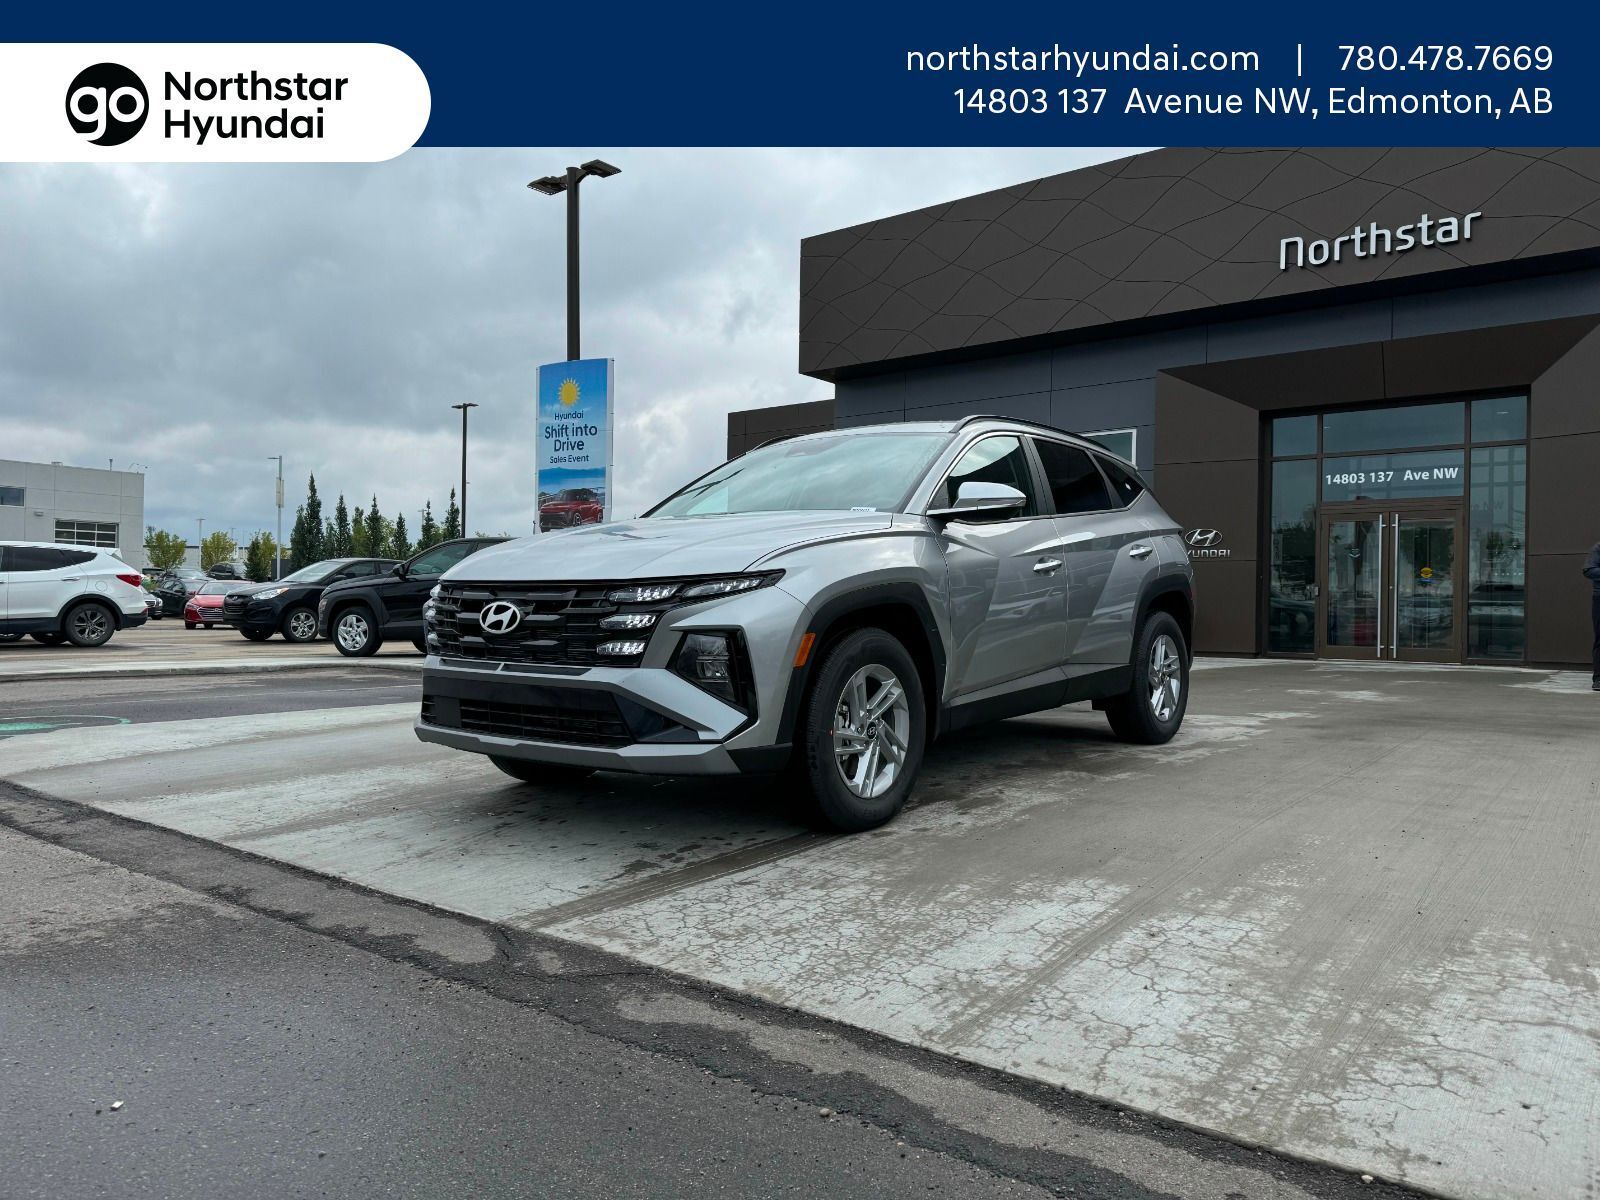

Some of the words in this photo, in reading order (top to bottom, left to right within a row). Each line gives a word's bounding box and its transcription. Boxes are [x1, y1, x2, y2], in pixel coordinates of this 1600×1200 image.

[554, 410, 584, 421] Hyundai
[544, 424, 569, 439] Shift
[572, 423, 598, 437] into
[554, 438, 585, 452] Drive
[550, 456, 567, 464] Sales
[568, 454, 589, 463] Event
[1325, 472, 1366, 485] 14803
[1369, 471, 1394, 483] 137
[1403, 469, 1430, 481] Ave
[1433, 467, 1459, 480] NW
[1187, 549, 1231, 558] UNDAI
